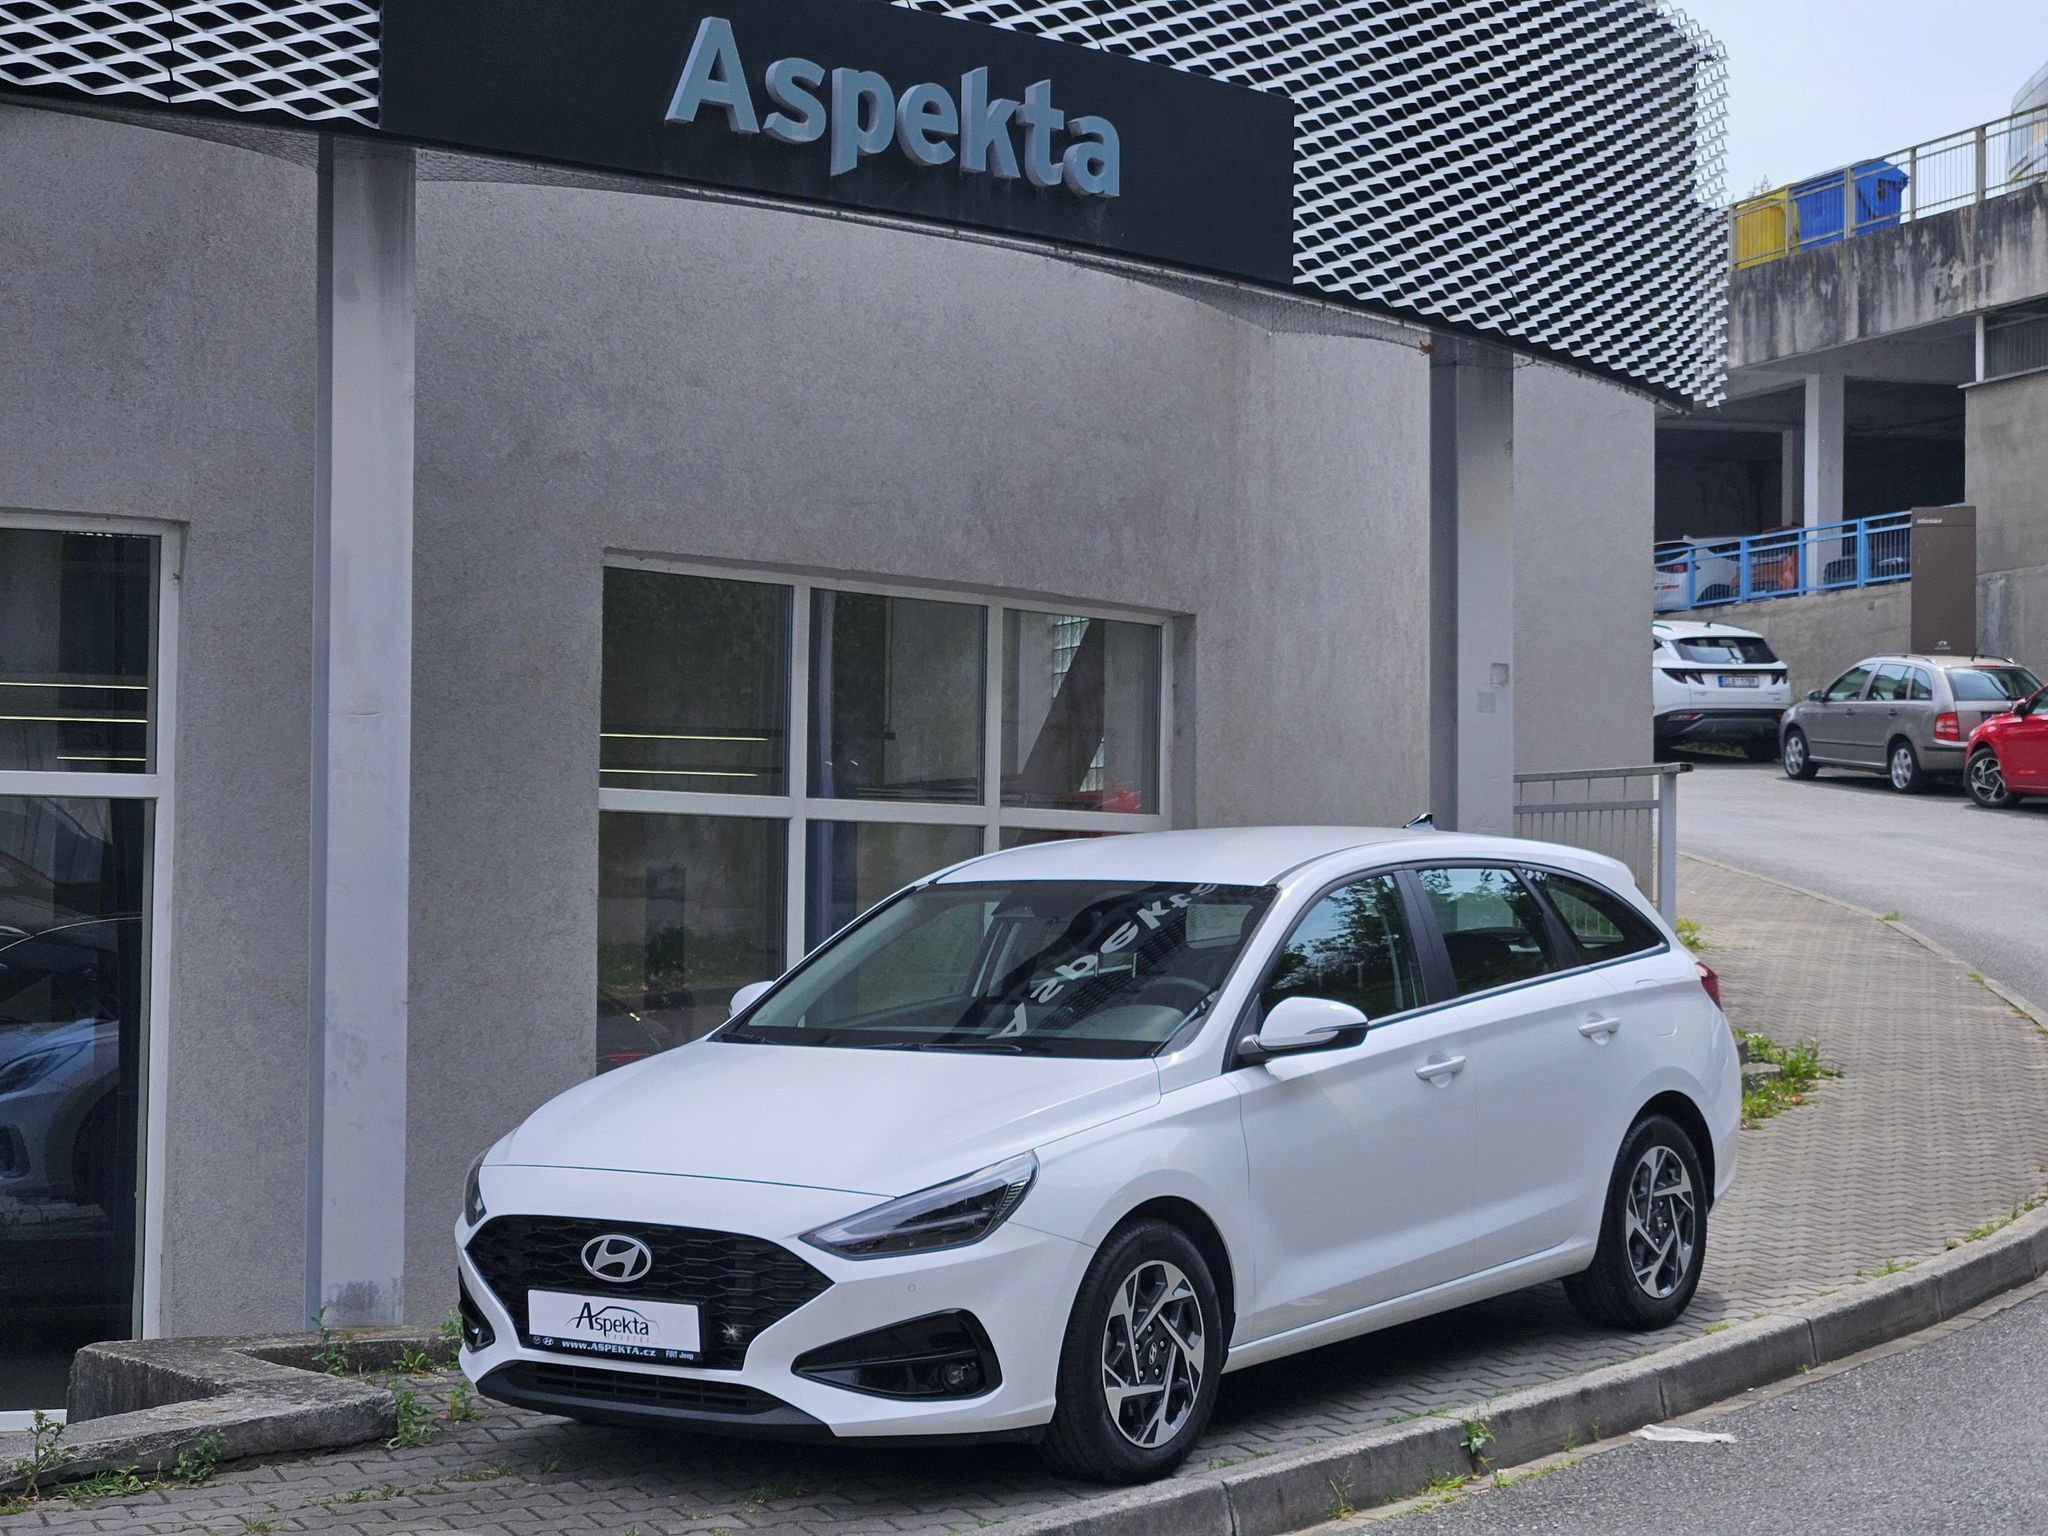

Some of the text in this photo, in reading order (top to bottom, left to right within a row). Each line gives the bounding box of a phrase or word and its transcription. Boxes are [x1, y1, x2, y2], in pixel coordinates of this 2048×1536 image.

[664, 16, 1120, 198] Aspekta
[576, 1302, 649, 1338] Aspekta
[679, 1352, 694, 1361] Jeep
